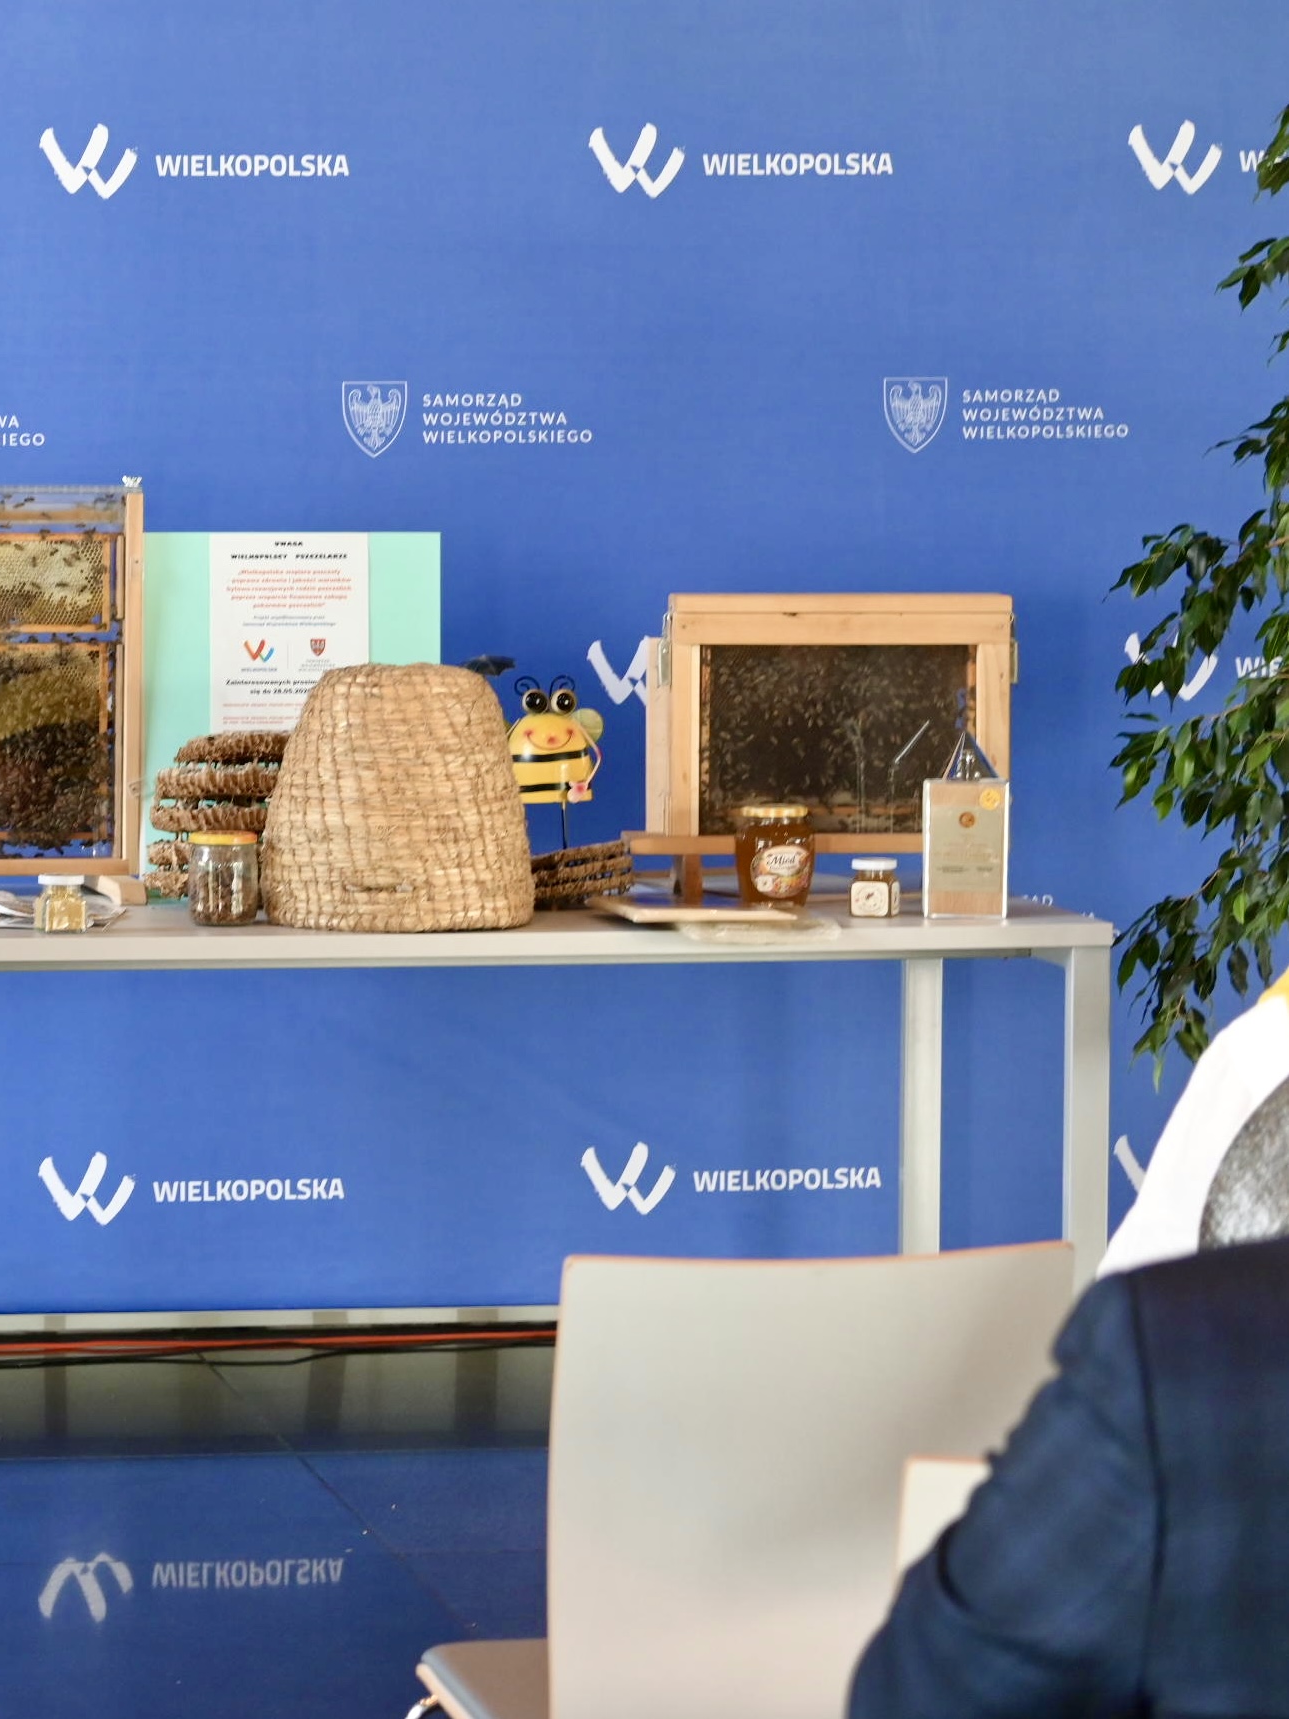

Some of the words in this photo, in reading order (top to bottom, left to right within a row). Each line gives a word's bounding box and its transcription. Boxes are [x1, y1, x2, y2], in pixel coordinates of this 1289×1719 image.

[155, 154, 350, 178] WIELKOPOLSKA
[702, 152, 894, 177] WIELKOPOLSKA
[422, 394, 522, 411] SAMORZĄD
[962, 389, 1060, 406] SAMORZĄD
[422, 410, 567, 427] WOJEWÓDZTWA
[962, 404, 1104, 422] WOJEWÓDZTWA
[422, 429, 593, 445] WIELKOPOLSKIEGO
[962, 424, 1129, 440] WIELKOPOLSKIEGO
[693, 1166, 882, 1193] WIELKOPOLSKA
[152, 1178, 345, 1203] WIELKOPOLSKA
